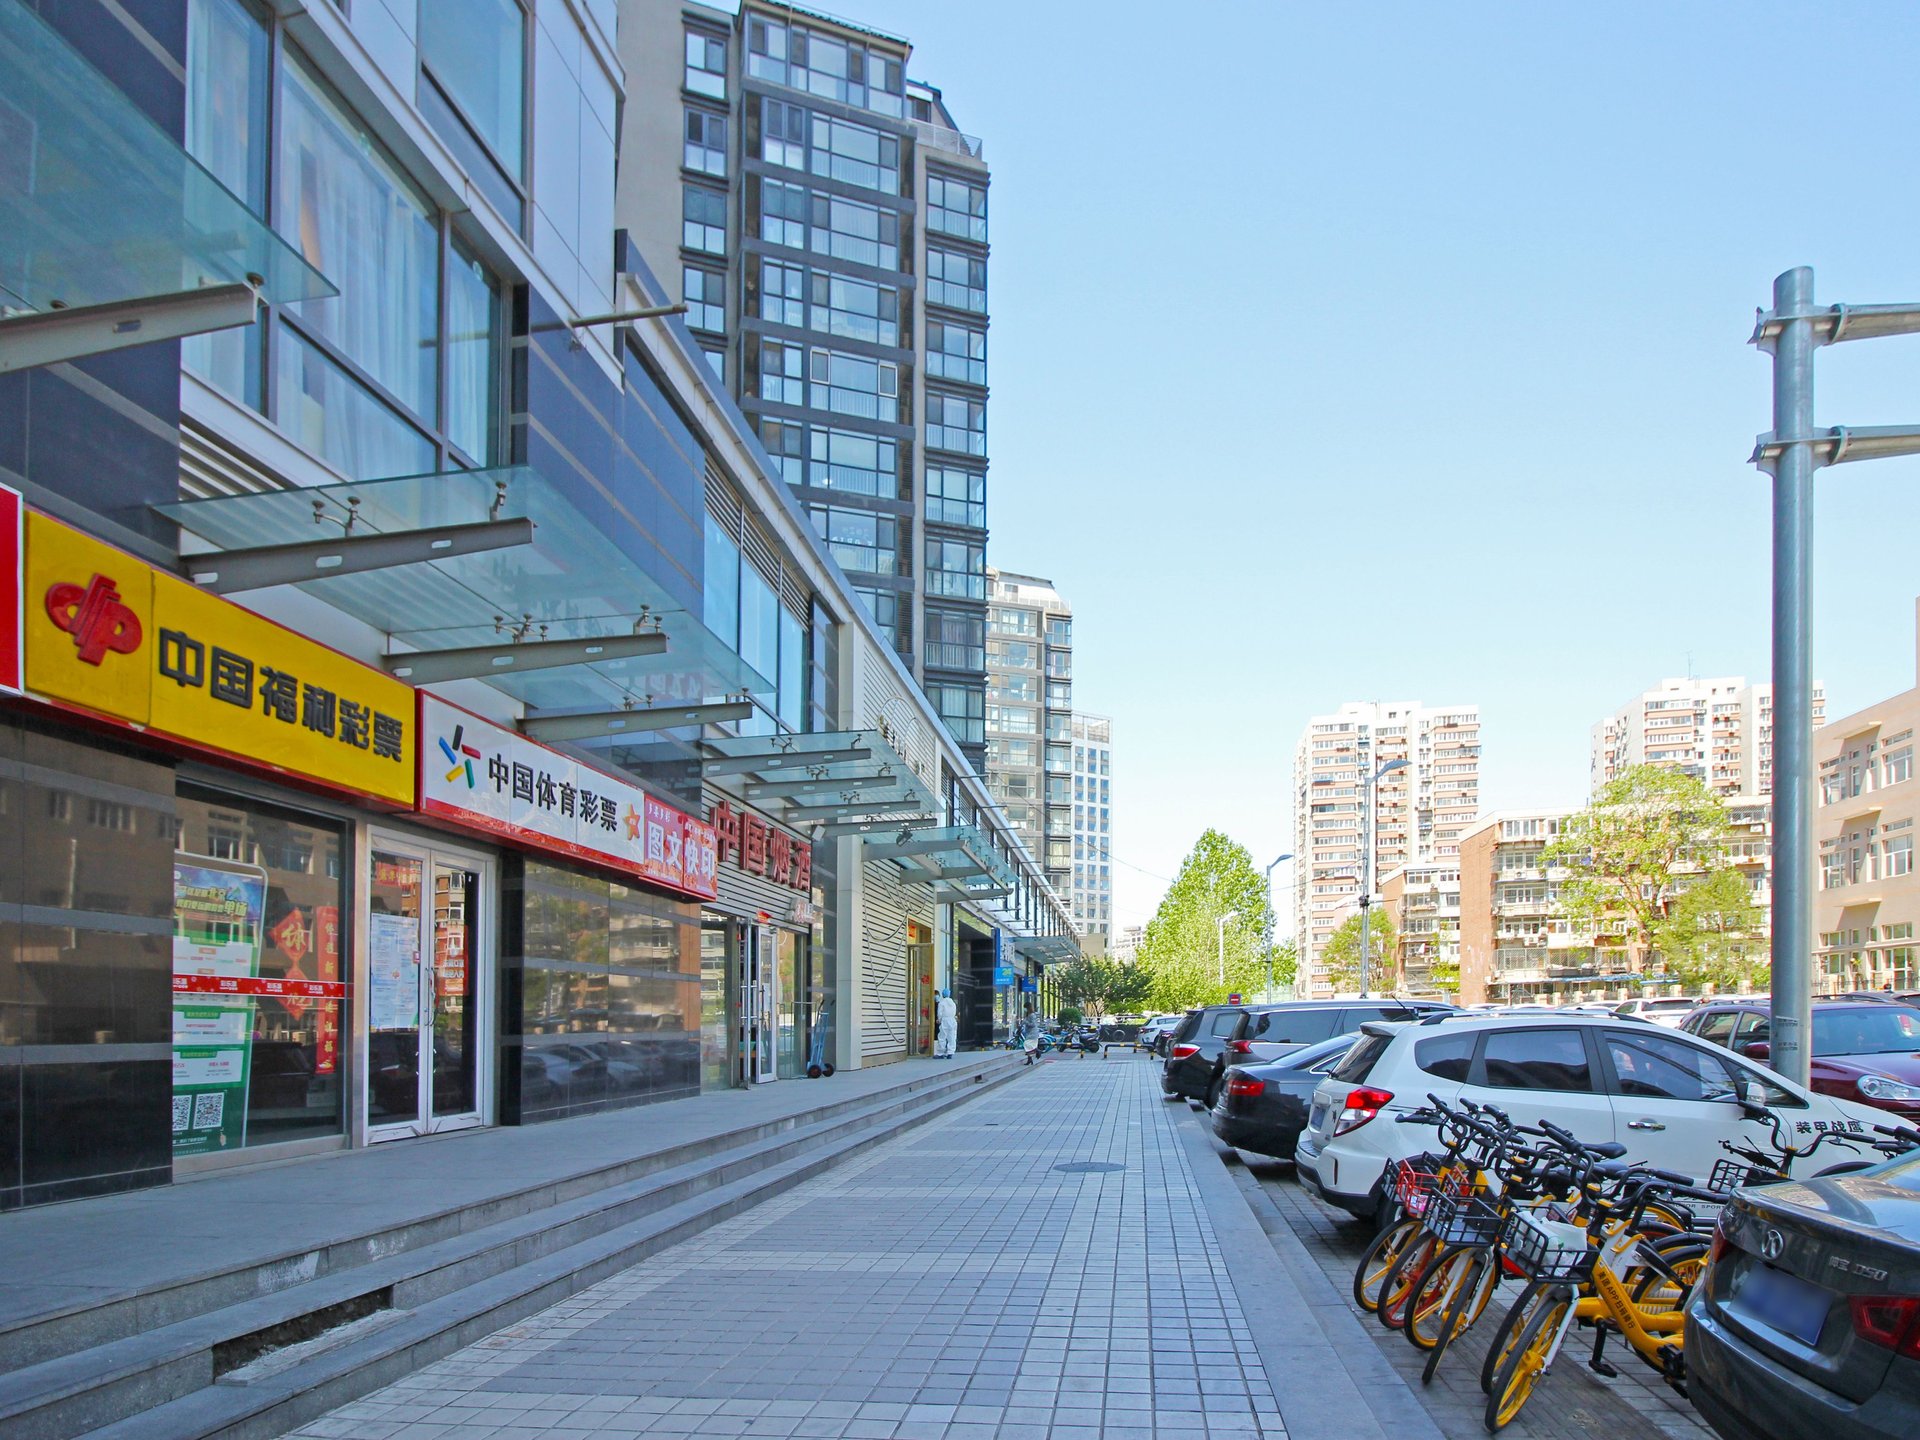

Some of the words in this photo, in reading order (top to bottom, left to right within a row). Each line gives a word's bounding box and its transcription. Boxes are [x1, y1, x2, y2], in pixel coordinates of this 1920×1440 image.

[160, 627, 403, 762] 中国福利彩票
[488, 753, 618, 832] 中国体育彩票
[647, 821, 715, 880] 图文快印
[1796, 1120, 1864, 1134] 装甲战鹰
[1853, 1263, 1889, 1282] D50
